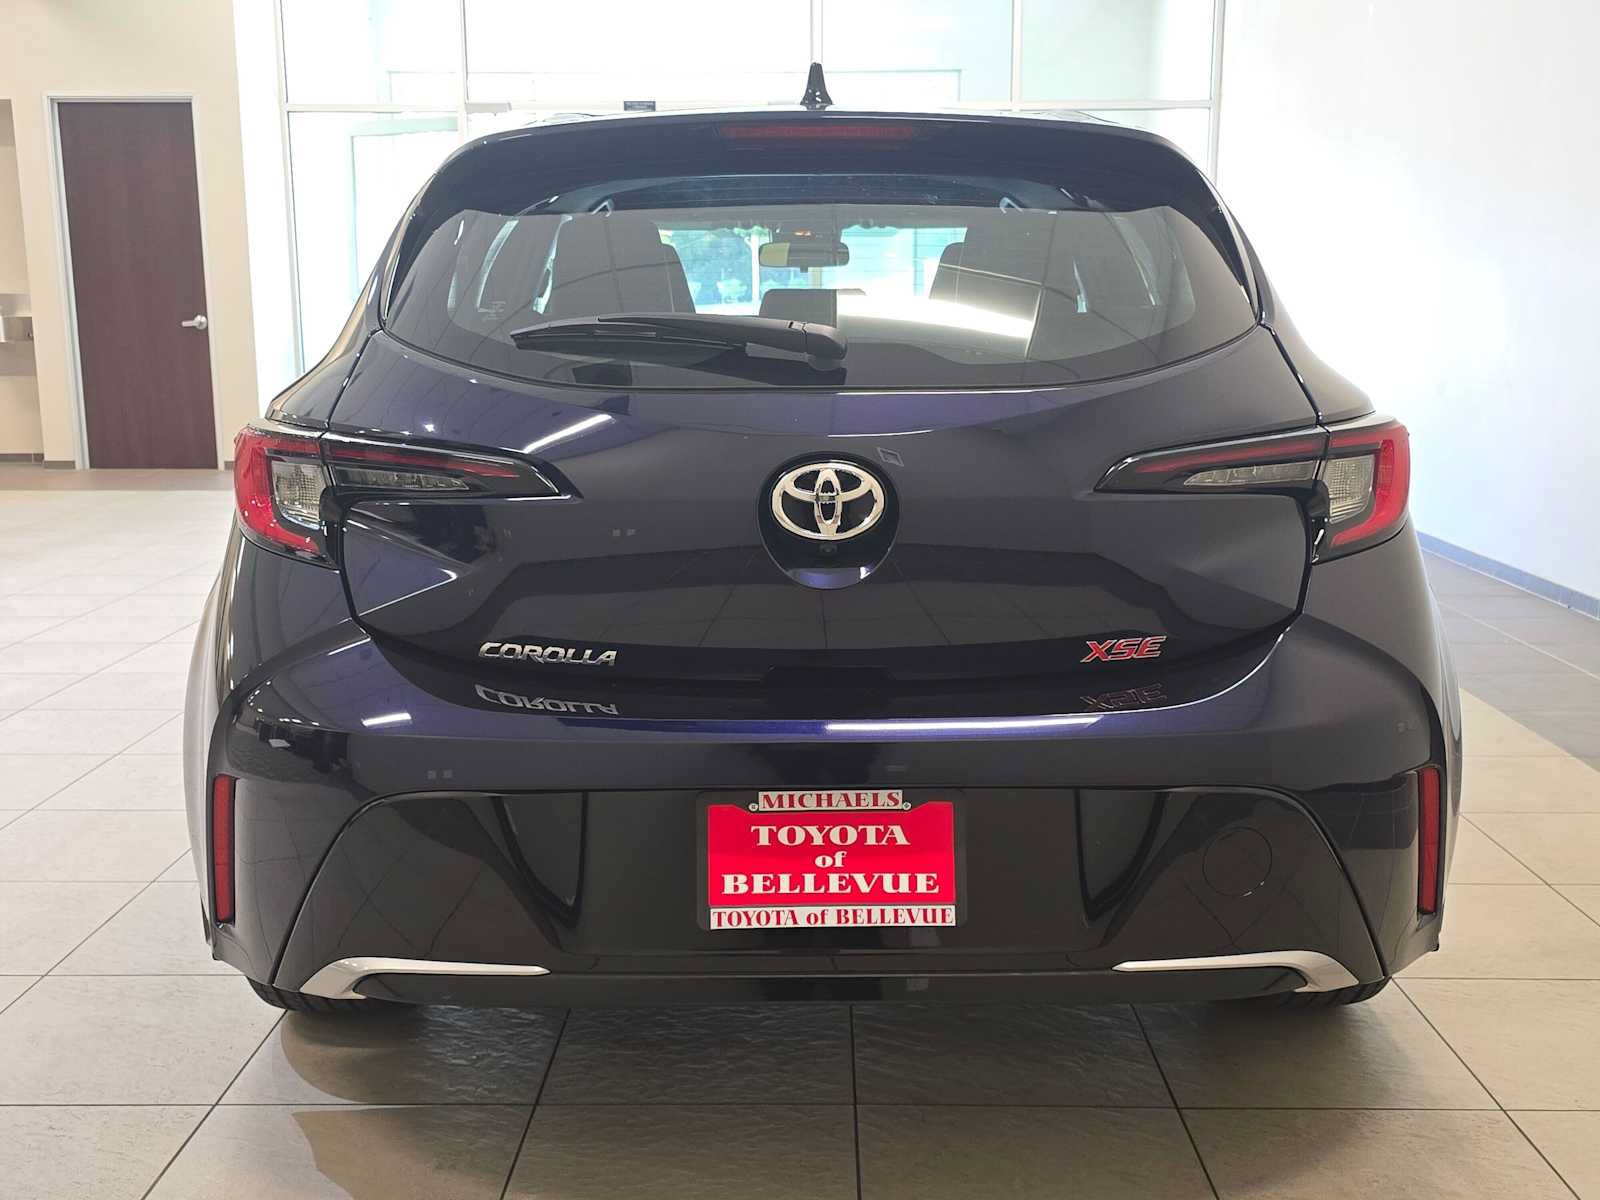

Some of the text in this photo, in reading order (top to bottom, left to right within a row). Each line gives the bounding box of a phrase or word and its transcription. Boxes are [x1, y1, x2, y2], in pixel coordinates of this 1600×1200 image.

[479, 642, 617, 666] COROLLA
[1080, 636, 1167, 662] XSE
[762, 792, 901, 808] MICHAELS
[751, 825, 910, 846] TOYOTA
[814, 851, 847, 868] of
[721, 873, 939, 895] BELLEVUE
[713, 908, 953, 927] TOYOTA of BELLEVUE
